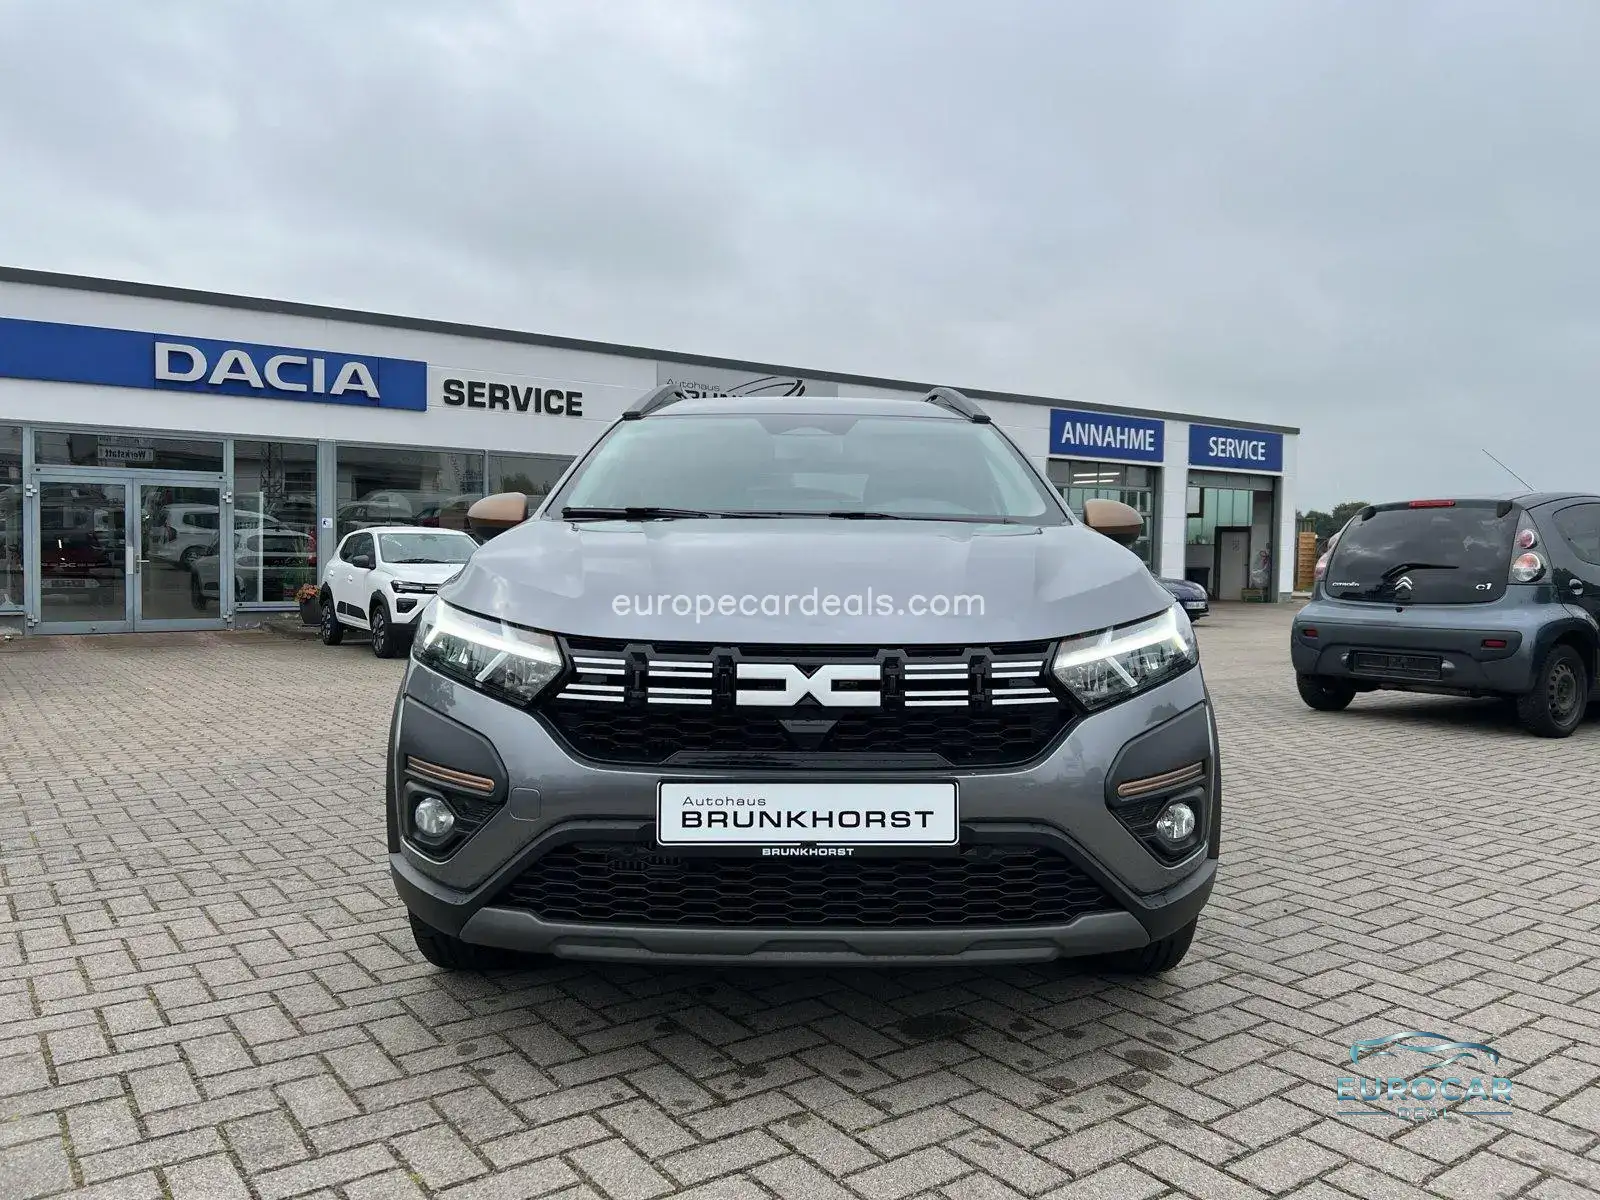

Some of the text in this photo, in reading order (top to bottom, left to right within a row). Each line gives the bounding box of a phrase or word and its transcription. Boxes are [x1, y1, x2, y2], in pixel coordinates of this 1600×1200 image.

[155, 341, 380, 399] DACIA
[667, 378, 720, 391] Atohaus
[443, 378, 584, 417] SERVICE
[1061, 421, 1155, 452] ANNAHME
[1208, 437, 1266, 461] SERVICE
[682, 796, 766, 806] Autohaus
[681, 811, 934, 828] BRUNKHORST
[762, 848, 855, 856] BRUNKHORST
